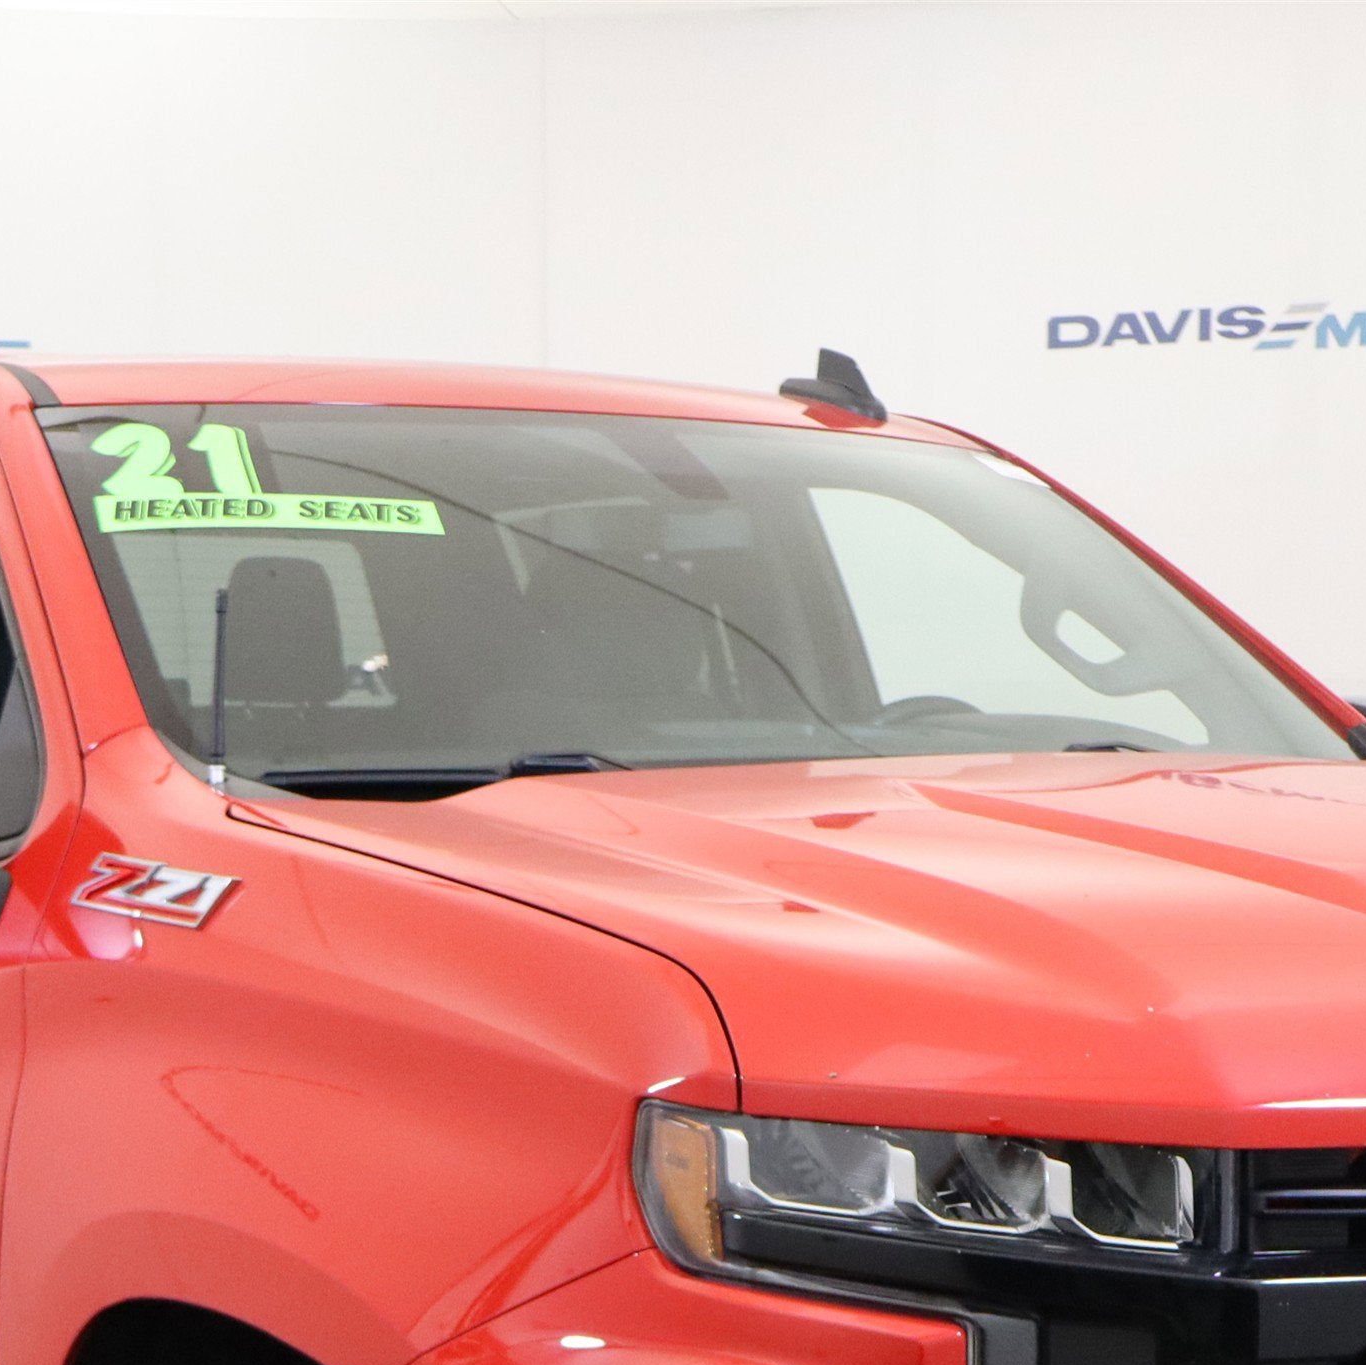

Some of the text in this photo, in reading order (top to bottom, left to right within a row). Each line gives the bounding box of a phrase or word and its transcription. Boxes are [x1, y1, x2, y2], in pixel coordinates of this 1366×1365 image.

[1047, 305, 1267, 350] DAVIS
[90, 422, 263, 496] 21
[113, 497, 423, 525] HEATED SEATS
